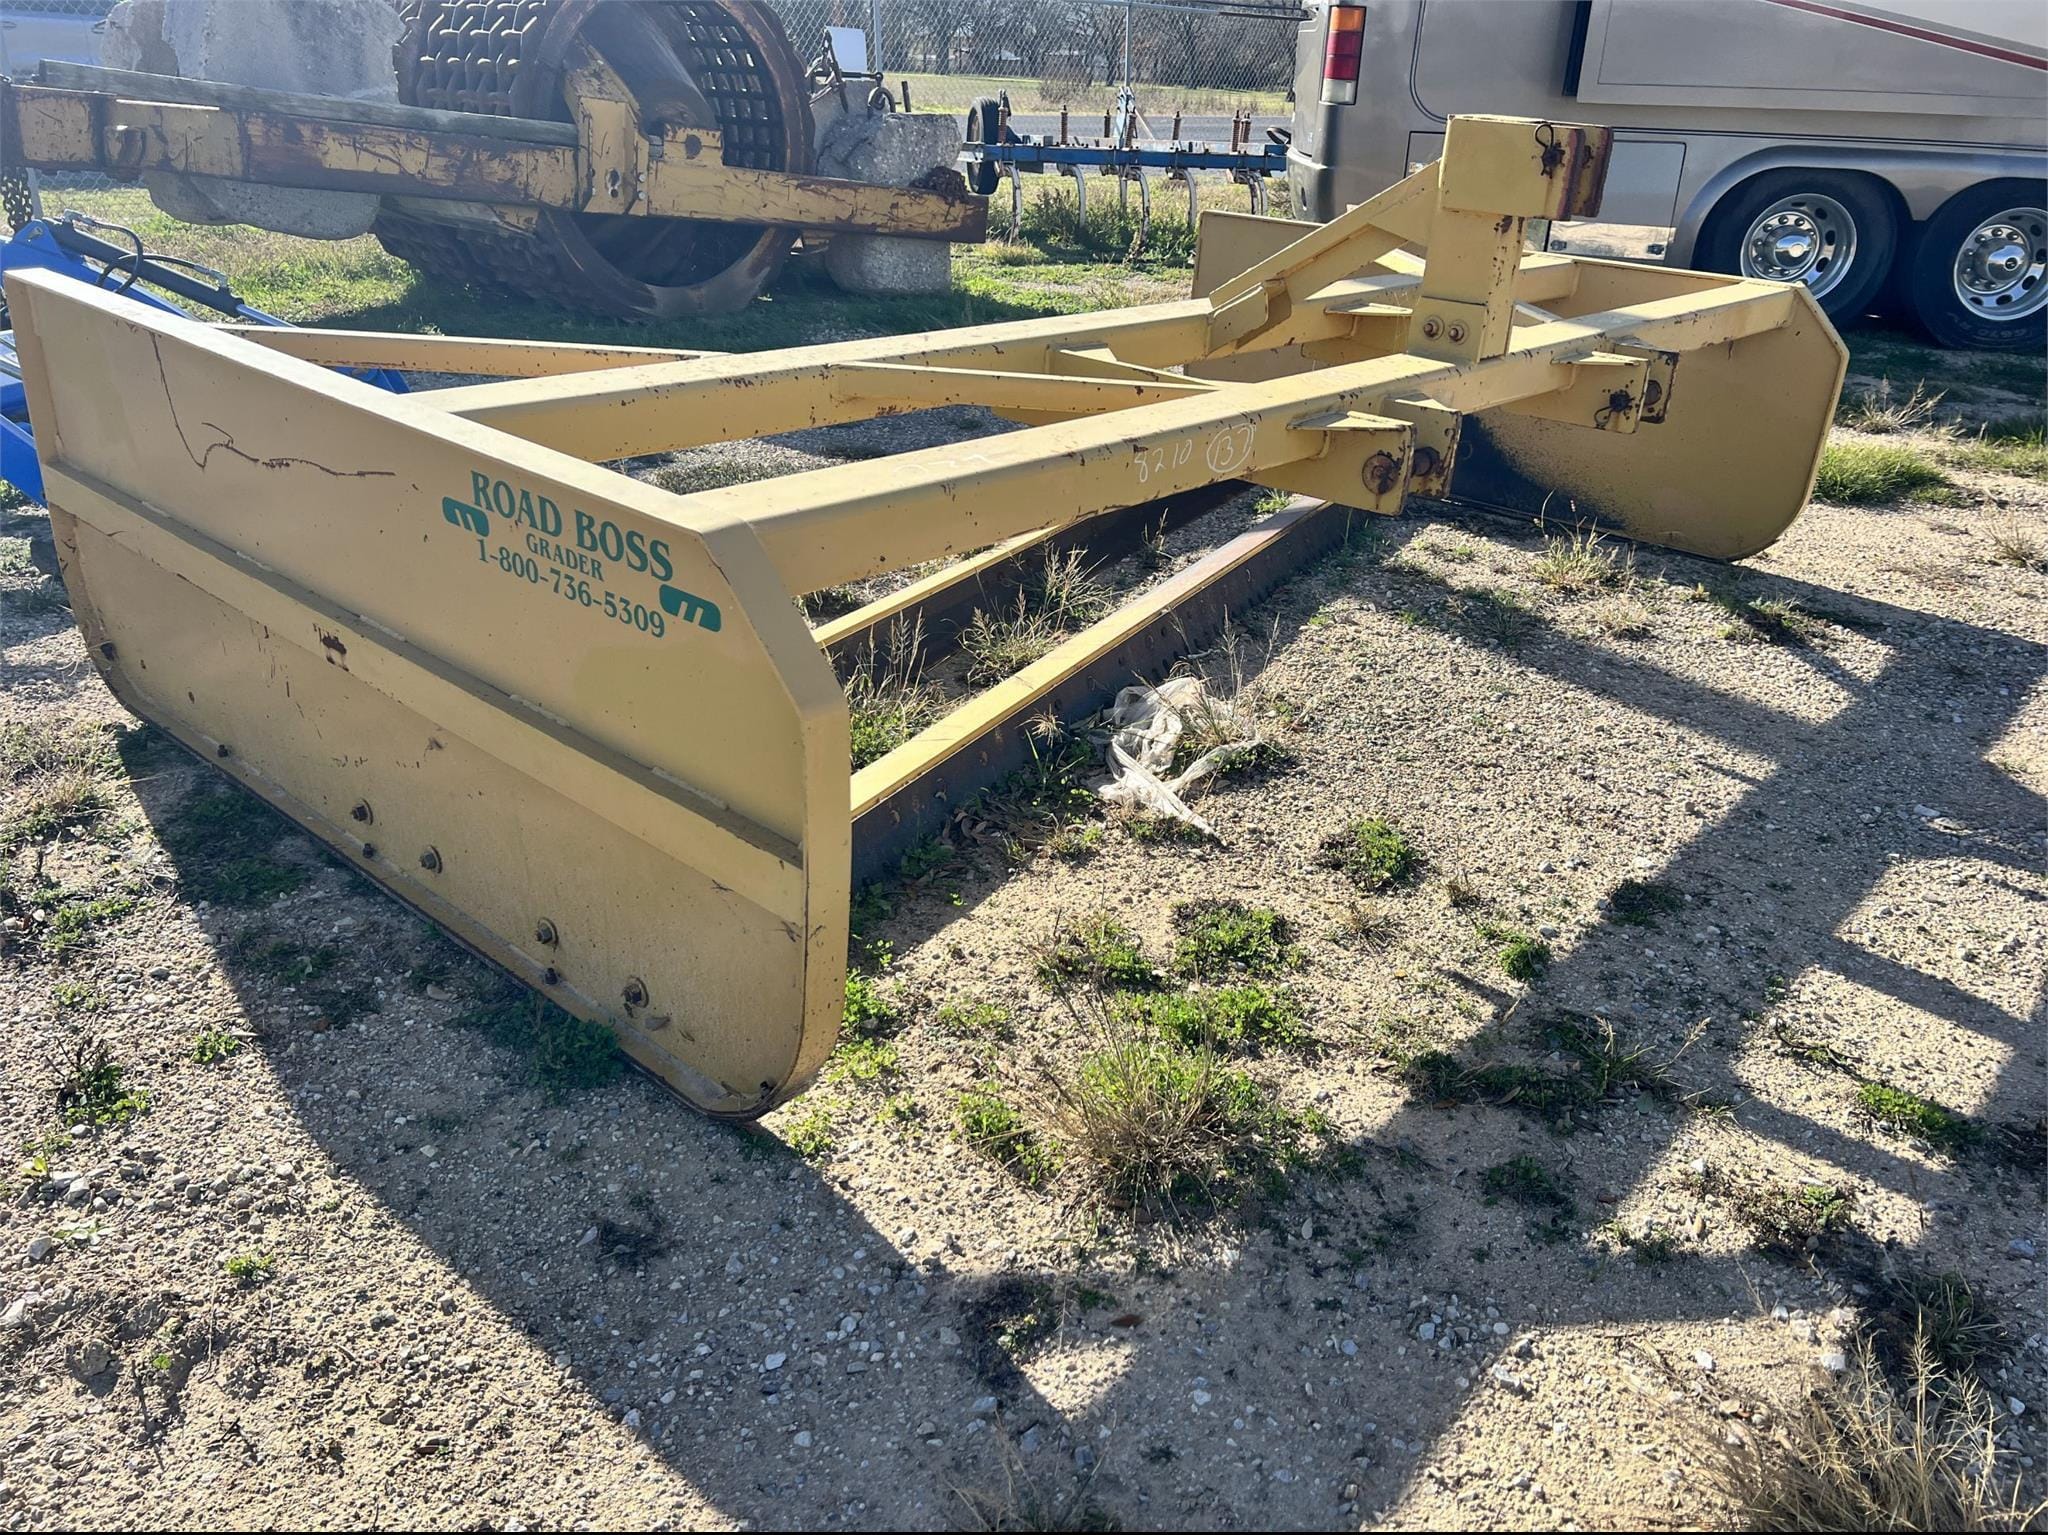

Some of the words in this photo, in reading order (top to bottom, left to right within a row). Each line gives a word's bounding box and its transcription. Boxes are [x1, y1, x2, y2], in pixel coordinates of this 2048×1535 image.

[1134, 439, 1193, 482] 8210
[471, 470, 562, 537] ROAD
[574, 508, 673, 582] BOSS
[525, 532, 604, 582] GRADER
[477, 539, 666, 638] 1-800-736-5309
